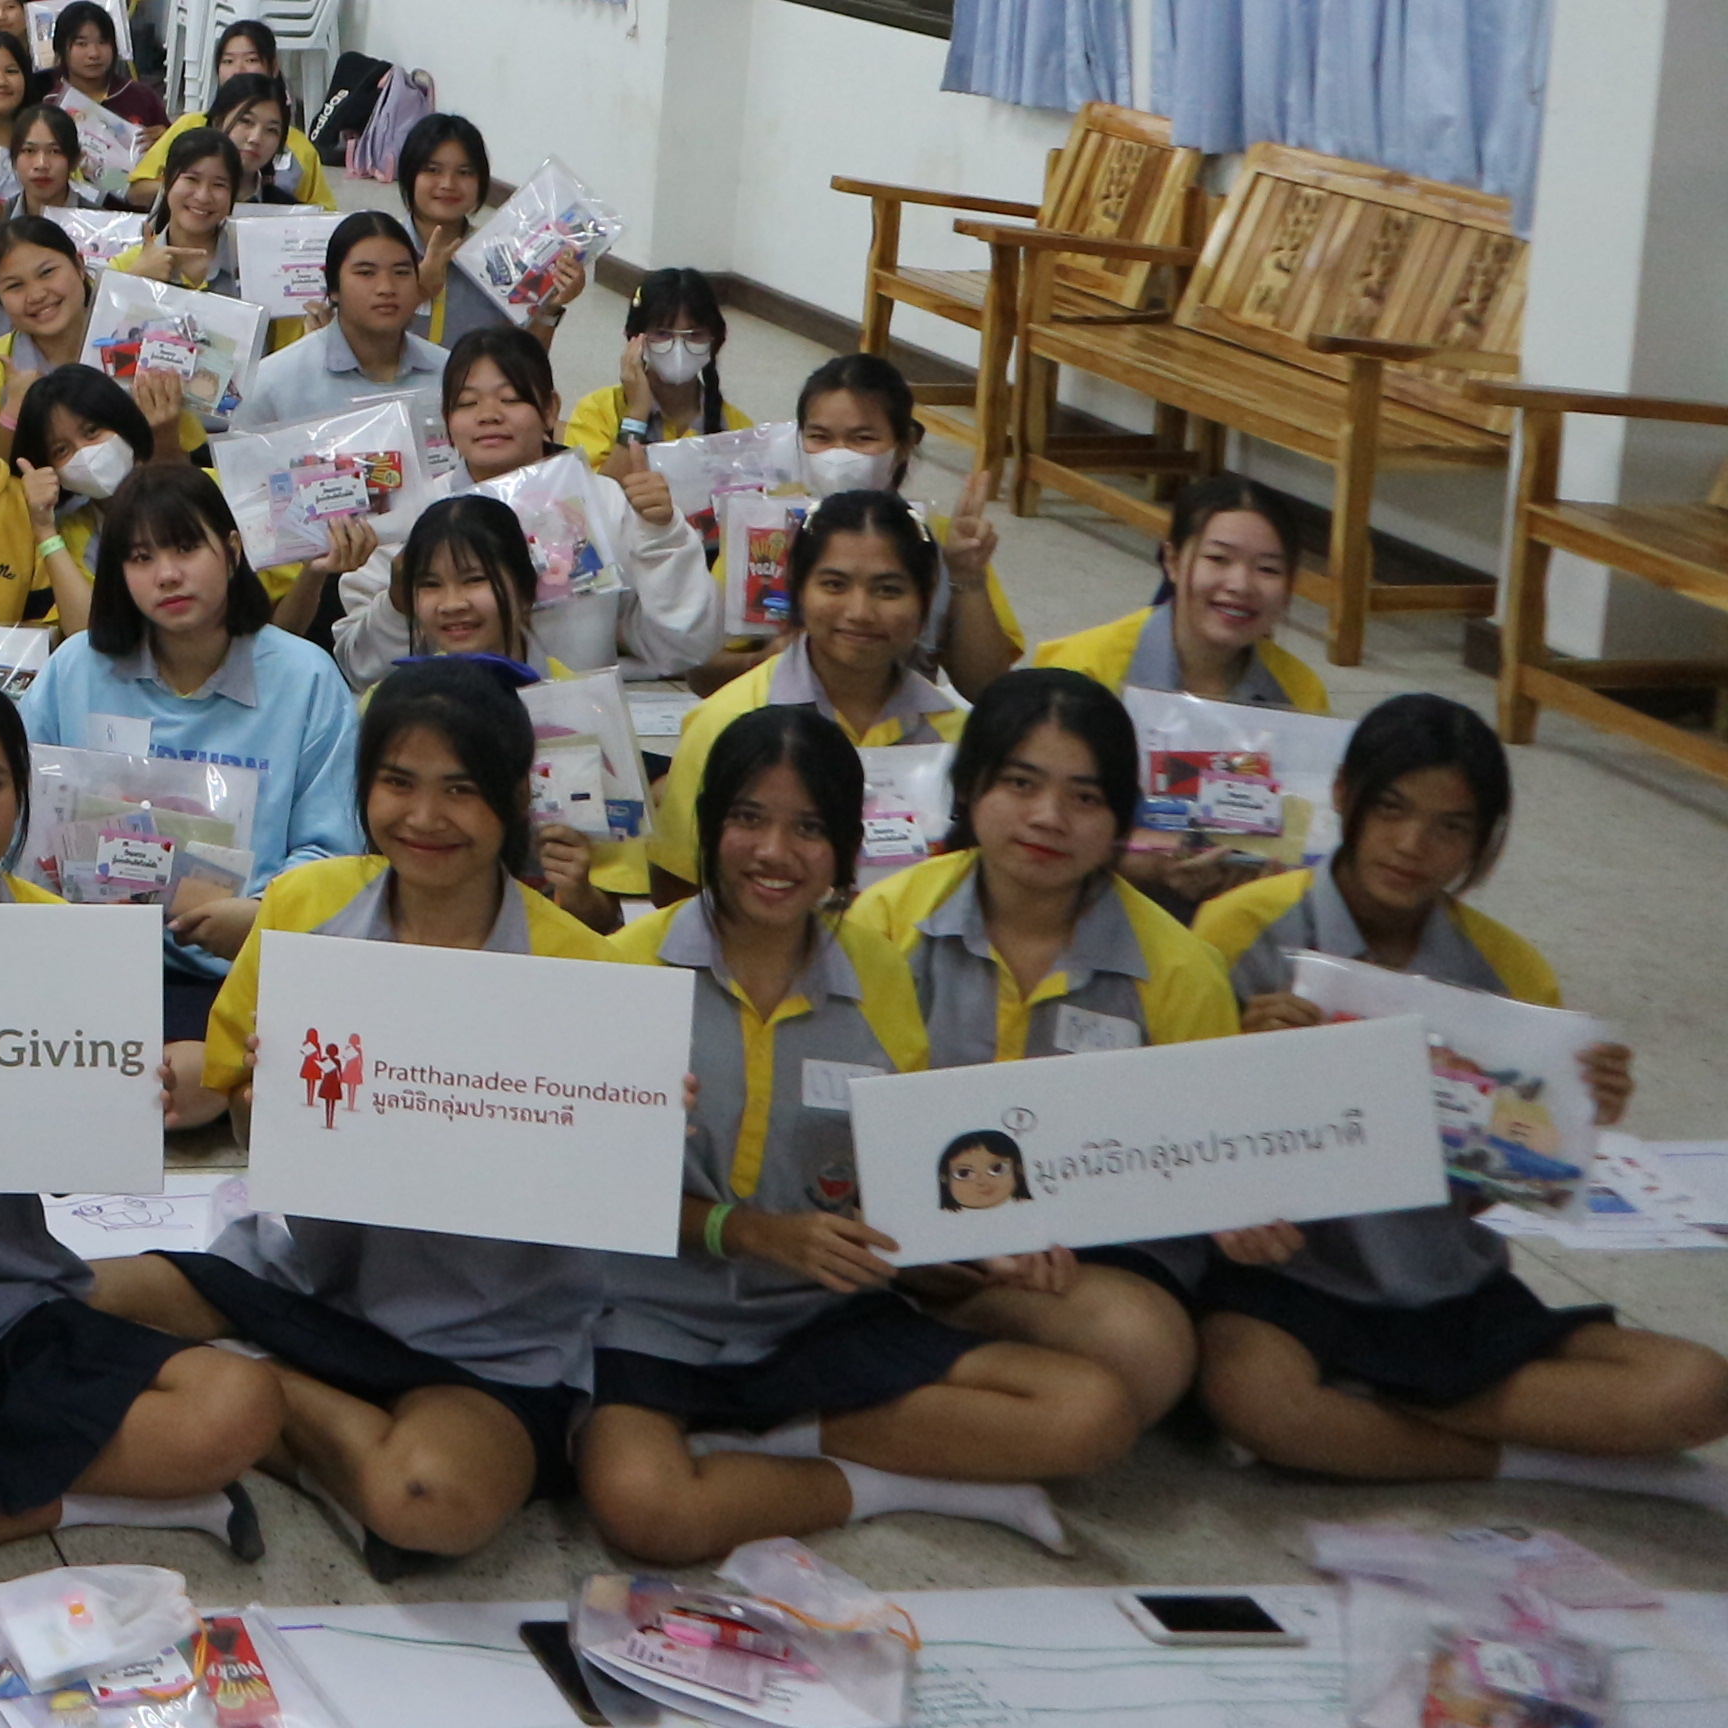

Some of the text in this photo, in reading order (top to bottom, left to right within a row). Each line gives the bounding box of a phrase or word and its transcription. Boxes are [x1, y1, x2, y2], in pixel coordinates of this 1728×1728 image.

[310, 88, 350, 142] adidas
[373, 1058, 668, 1106] Pratthanadee Foundation
[371, 1089, 576, 1127] มูลนิธิกลุ่มปรารถนาดี
[1031, 1109, 1367, 1194] มูลนิธิกลุ่มปรารถนาดี
